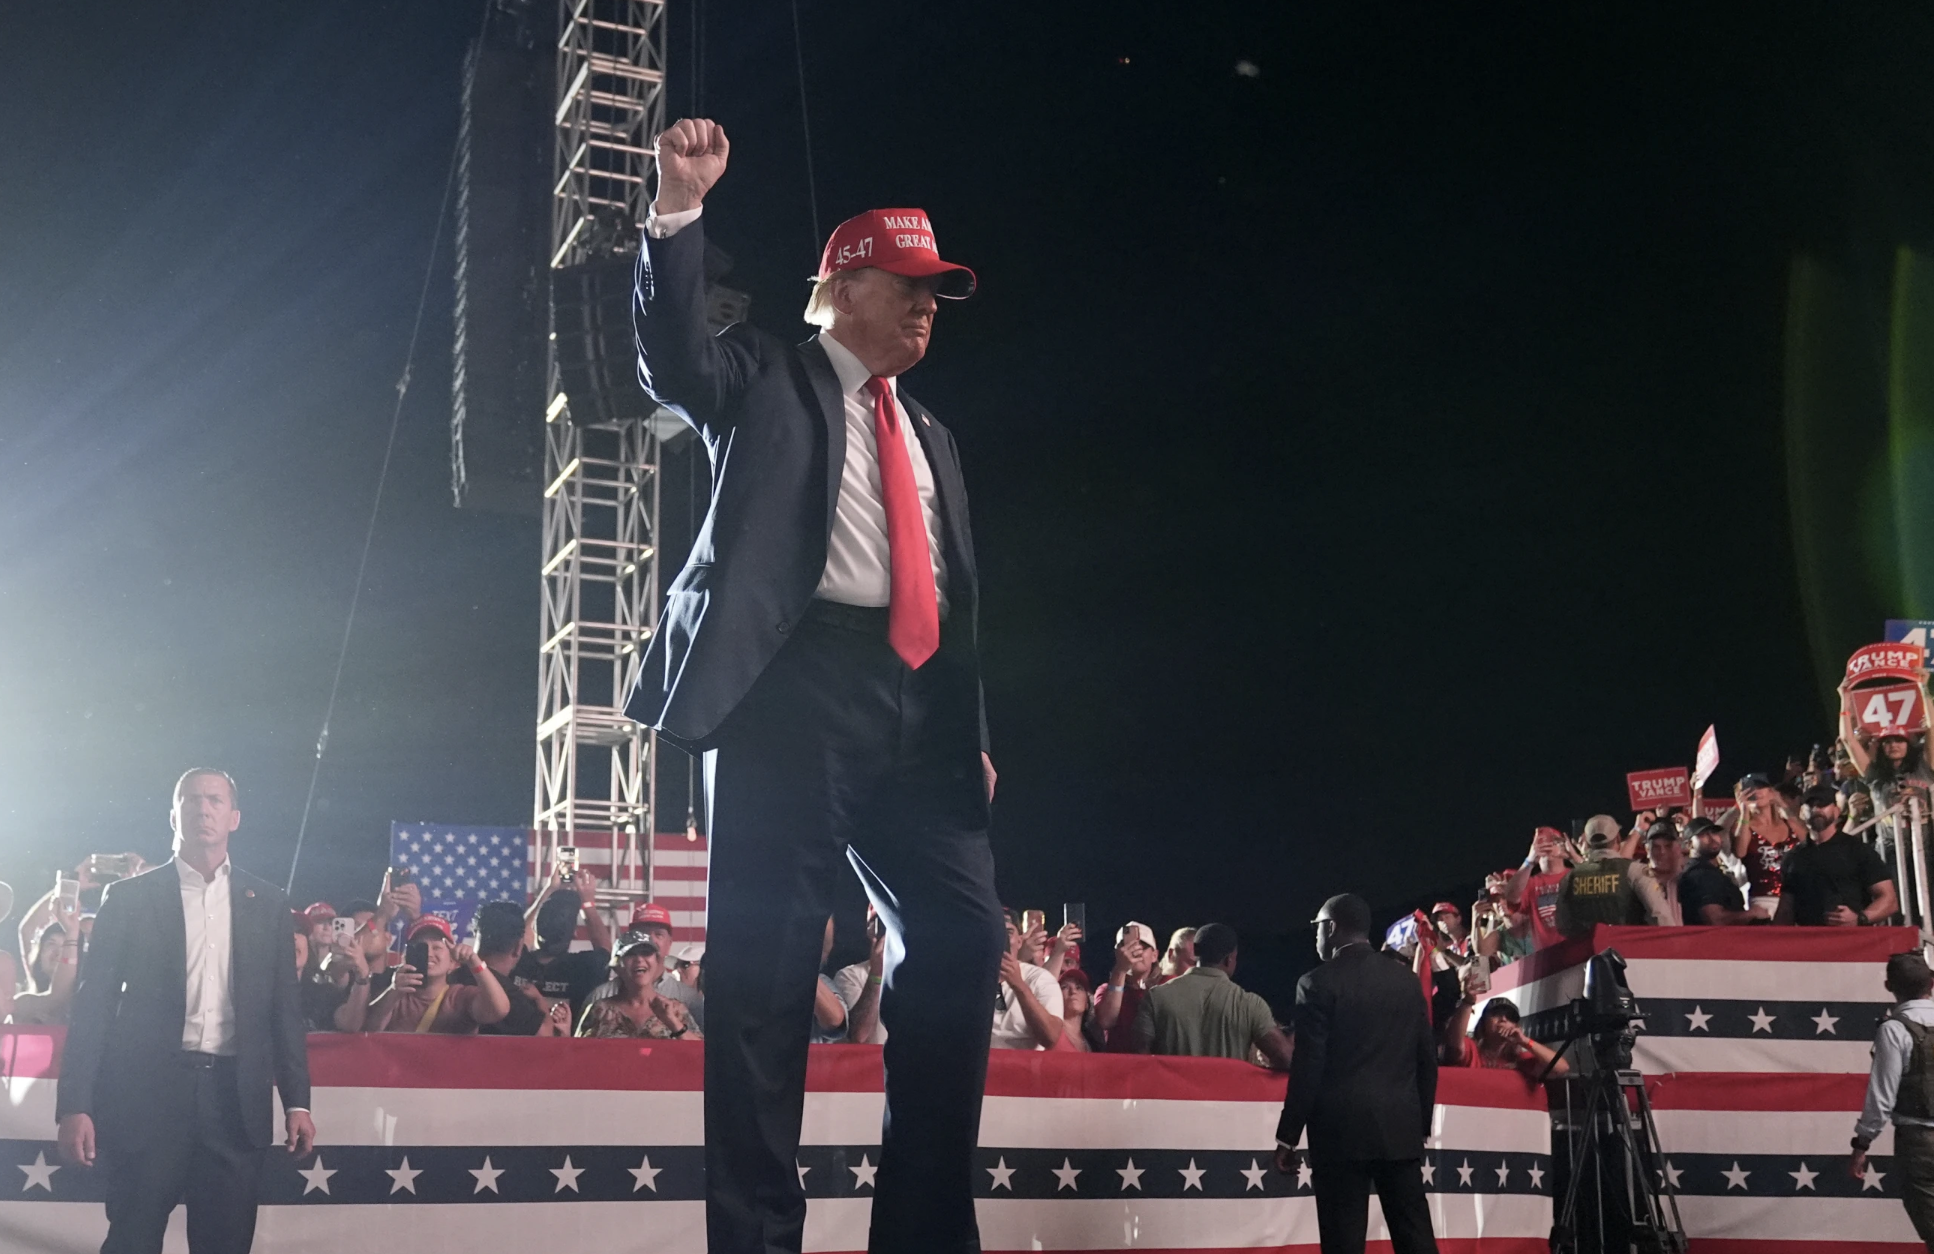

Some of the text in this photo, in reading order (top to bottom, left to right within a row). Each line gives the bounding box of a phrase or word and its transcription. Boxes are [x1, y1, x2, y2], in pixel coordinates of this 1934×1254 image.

[884, 216, 920, 230] MAKE
[895, 234, 931, 249] GREAT
[835, 237, 873, 265] 45-47
[1849, 651, 1918, 671] TRUMP
[1853, 659, 1910, 674] VANCE
[1862, 690, 1917, 727] 47
[1632, 776, 1685, 792] TRUMP
[1639, 786, 1680, 798] VANCE
[1573, 874, 1620, 895] SHERIFF
[1387, 917, 1415, 945] 47
